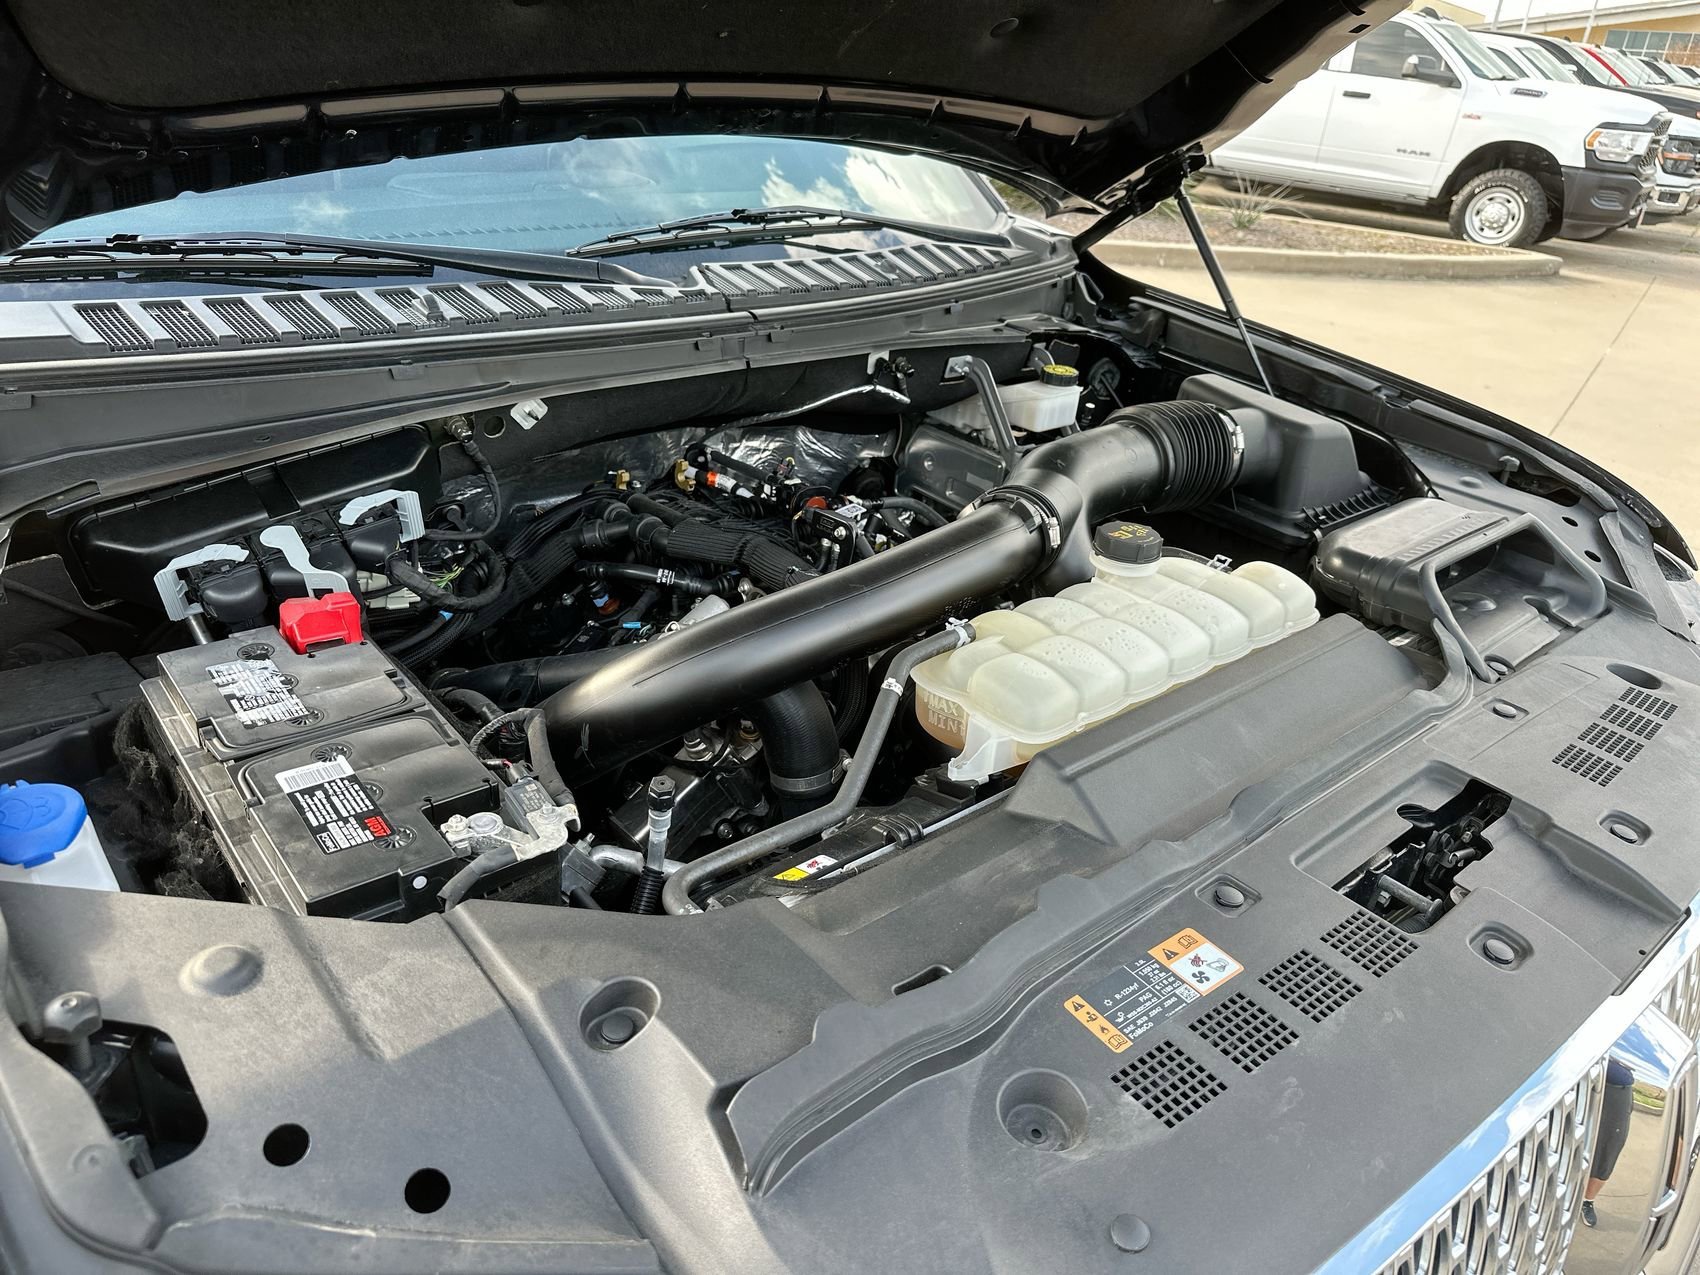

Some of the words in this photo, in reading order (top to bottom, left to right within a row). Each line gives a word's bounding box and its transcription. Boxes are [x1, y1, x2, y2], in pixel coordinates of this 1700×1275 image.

[929, 694, 958, 716] MAX
[928, 709, 958, 733] MIN
[363, 817, 387, 837] AGM
[1115, 982, 1139, 1000] R-1234yf
[1172, 980, 1182, 988] cc)
[1139, 992, 1153, 1002] PAG
[1123, 1025, 1136, 1034] SAE
[1128, 1021, 1154, 1039] FoMoCo
